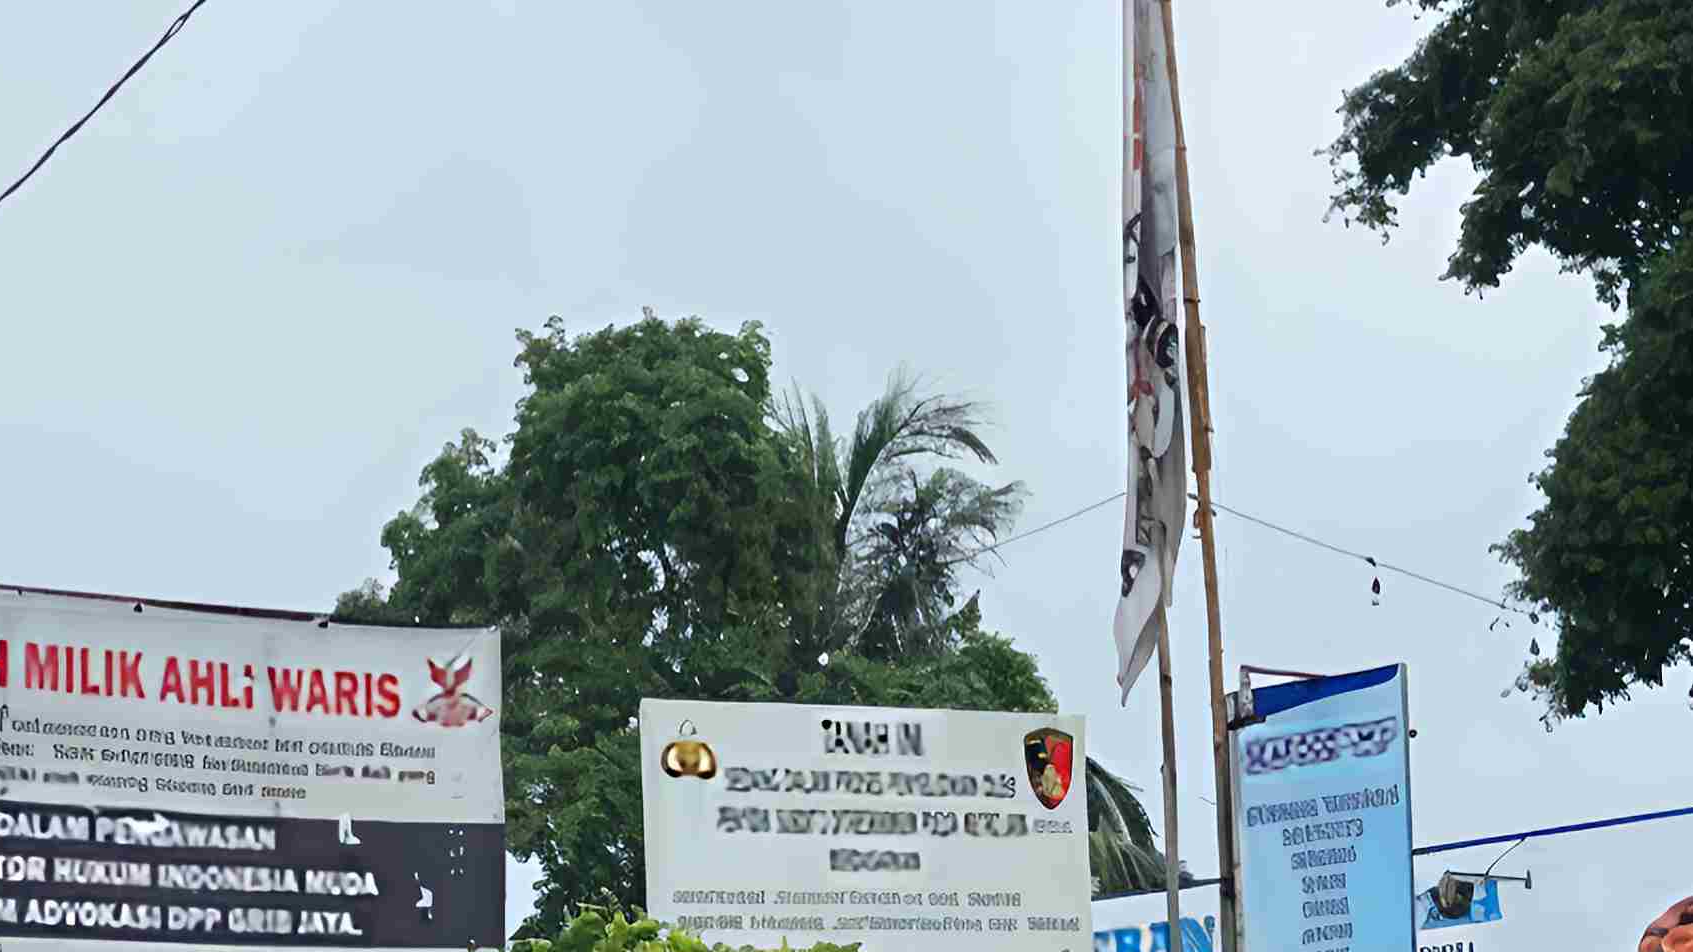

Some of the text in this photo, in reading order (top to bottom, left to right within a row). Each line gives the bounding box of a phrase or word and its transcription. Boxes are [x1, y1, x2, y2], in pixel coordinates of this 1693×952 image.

[24, 642, 146, 700] MILIK
[267, 666, 400, 718] WARIS
[53, 857, 152, 887] HUKUM
[158, 863, 299, 893] INDONESIA
[306, 869, 379, 896] MUDA
[25, 899, 162, 930] ADVOKASI
[168, 906, 221, 931] DPP
